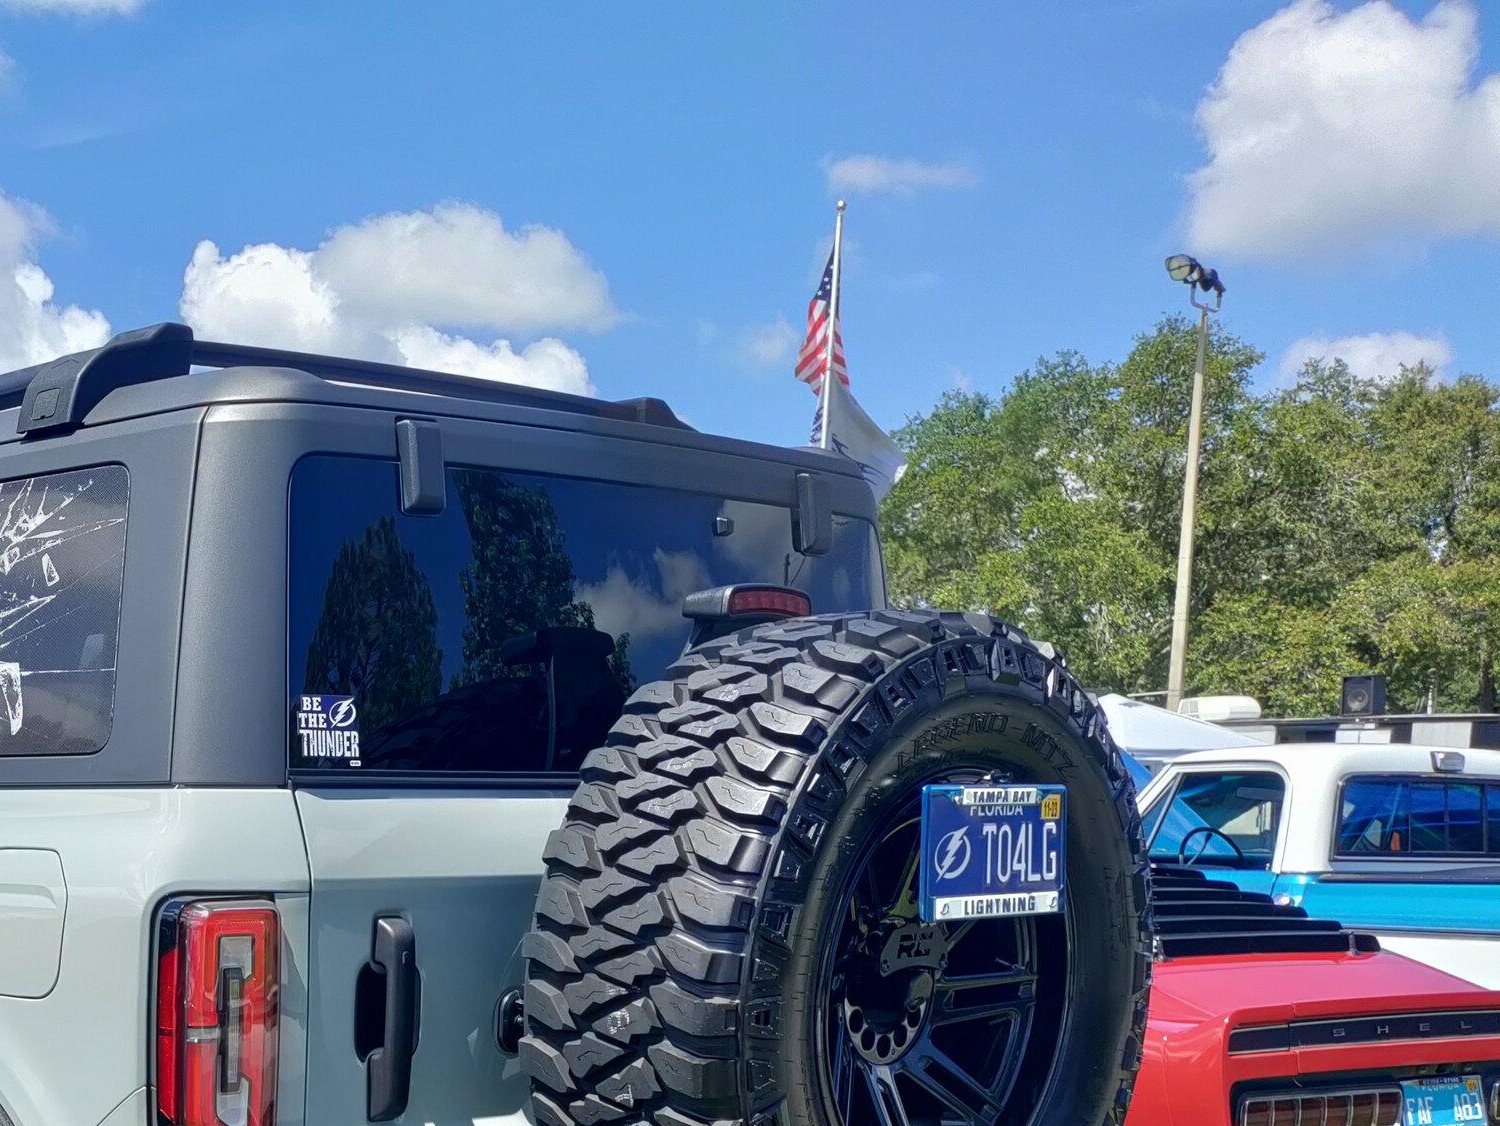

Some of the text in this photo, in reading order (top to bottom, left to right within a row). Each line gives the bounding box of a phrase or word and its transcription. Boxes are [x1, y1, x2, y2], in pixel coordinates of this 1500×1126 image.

[302, 696, 322, 712] BE
[299, 712, 328, 728] THE
[299, 729, 360, 758] THUNDER
[972, 789, 1032, 804] TAMPA BAY
[963, 895, 1036, 916] LIGHTNING
